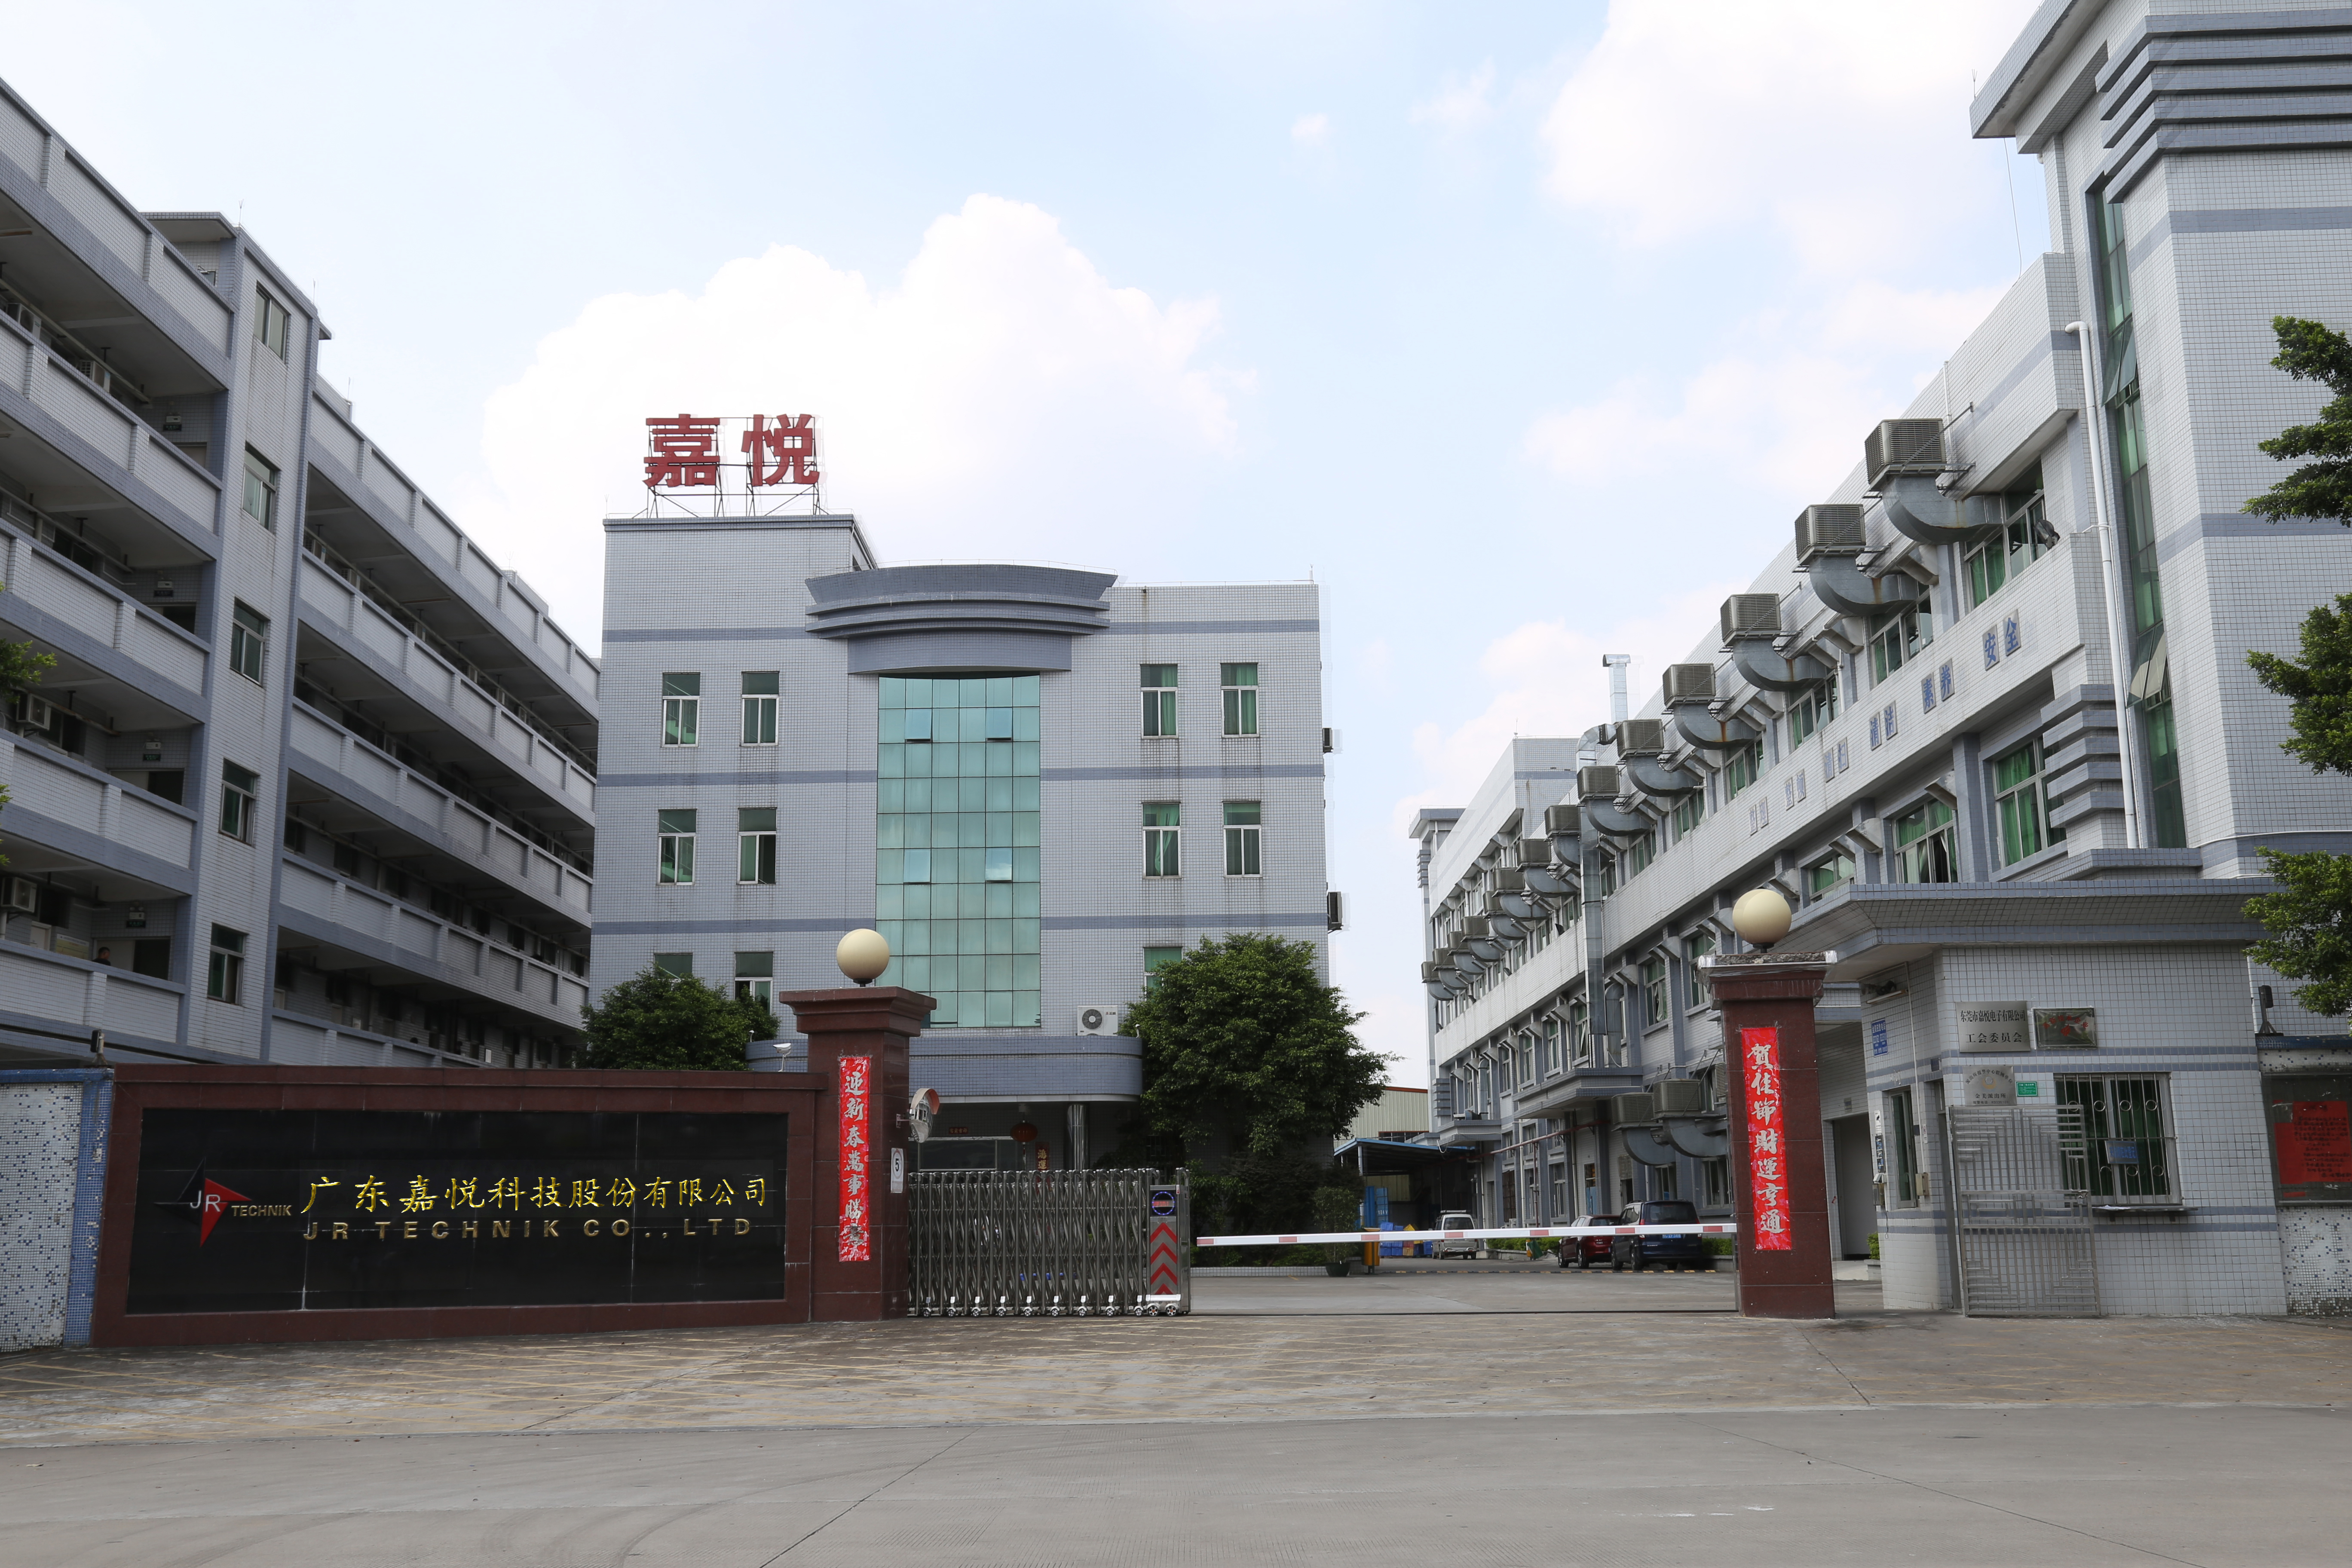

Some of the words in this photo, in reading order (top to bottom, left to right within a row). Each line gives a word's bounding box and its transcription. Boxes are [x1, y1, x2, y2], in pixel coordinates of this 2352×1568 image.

[642, 413, 820, 487] 嘉悦
[1749, 799, 1767, 833] 整理
[1785, 772, 1804, 807] 整顿
[1824, 742, 1847, 778] 清扫
[1870, 706, 1894, 747] 清洁
[1923, 665, 1951, 710] 素养
[1984, 617, 2019, 668] 安全
[1960, 1009, 2026, 1023] 东莞市嘉悦电子有限公司
[1966, 1032, 2022, 1043] 工会委员会
[1966, 1069, 2013, 1084] 派出所报警中心联网单位
[895, 1158, 899, 1172] 5
[190, 1190, 221, 1213] JR
[231, 1205, 292, 1217] TECHNIK
[301, 1175, 766, 1213] 广东嘉悦科技股份有限公司
[303, 1222, 349, 1240] JR
[375, 1220, 560, 1239] TECHNIK
